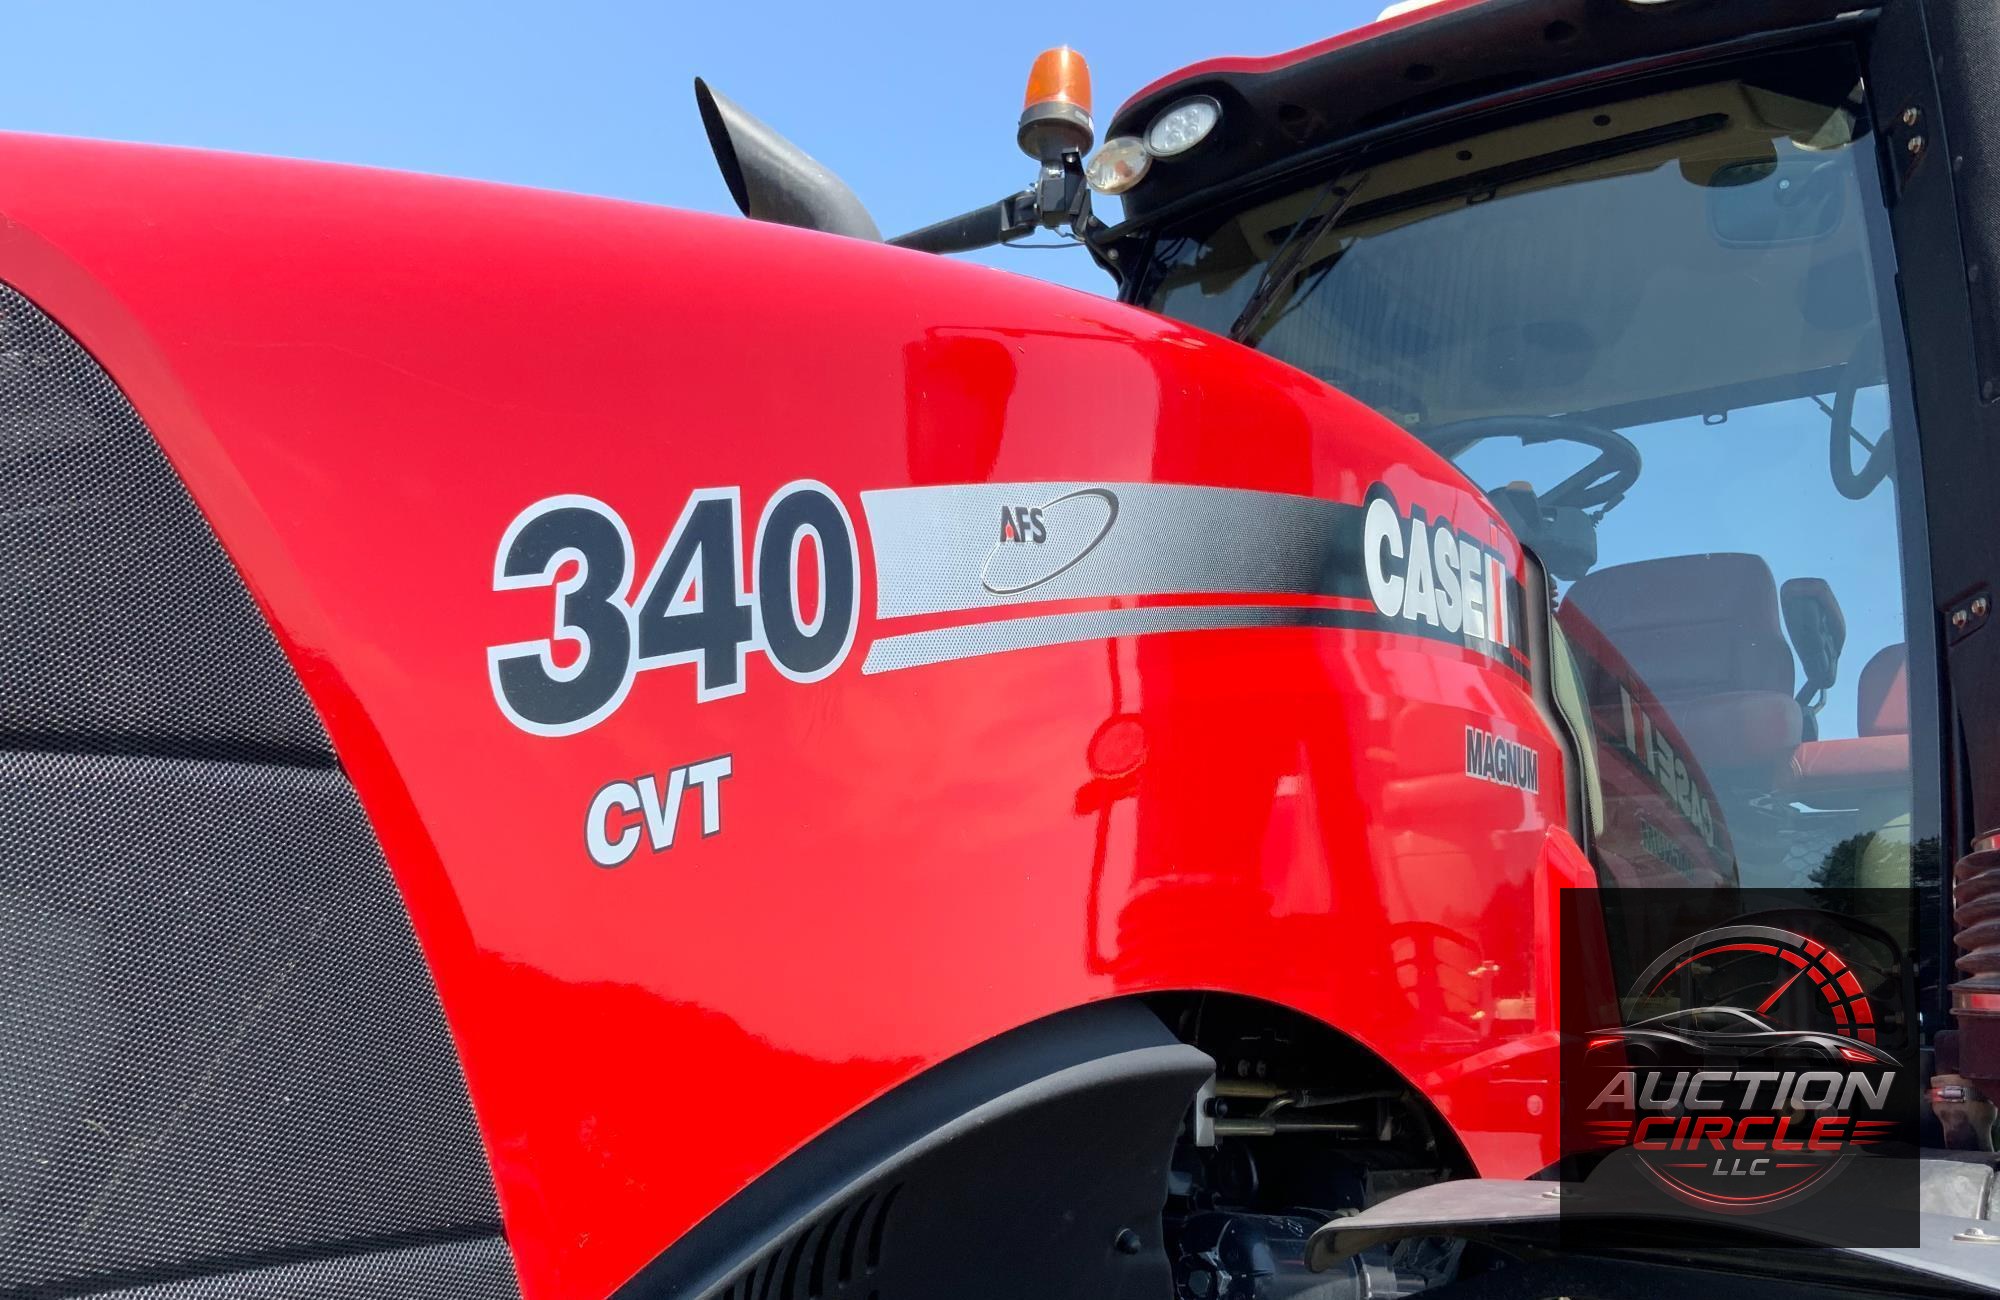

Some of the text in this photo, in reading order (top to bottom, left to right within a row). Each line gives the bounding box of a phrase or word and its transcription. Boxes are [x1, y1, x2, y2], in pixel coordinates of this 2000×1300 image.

[1000, 505, 1046, 543] AFS
[1364, 498, 1484, 639] CASE
[488, 479, 861, 737] 340
[585, 754, 733, 869] CVT
[1465, 724, 1539, 795] MAGNUM
